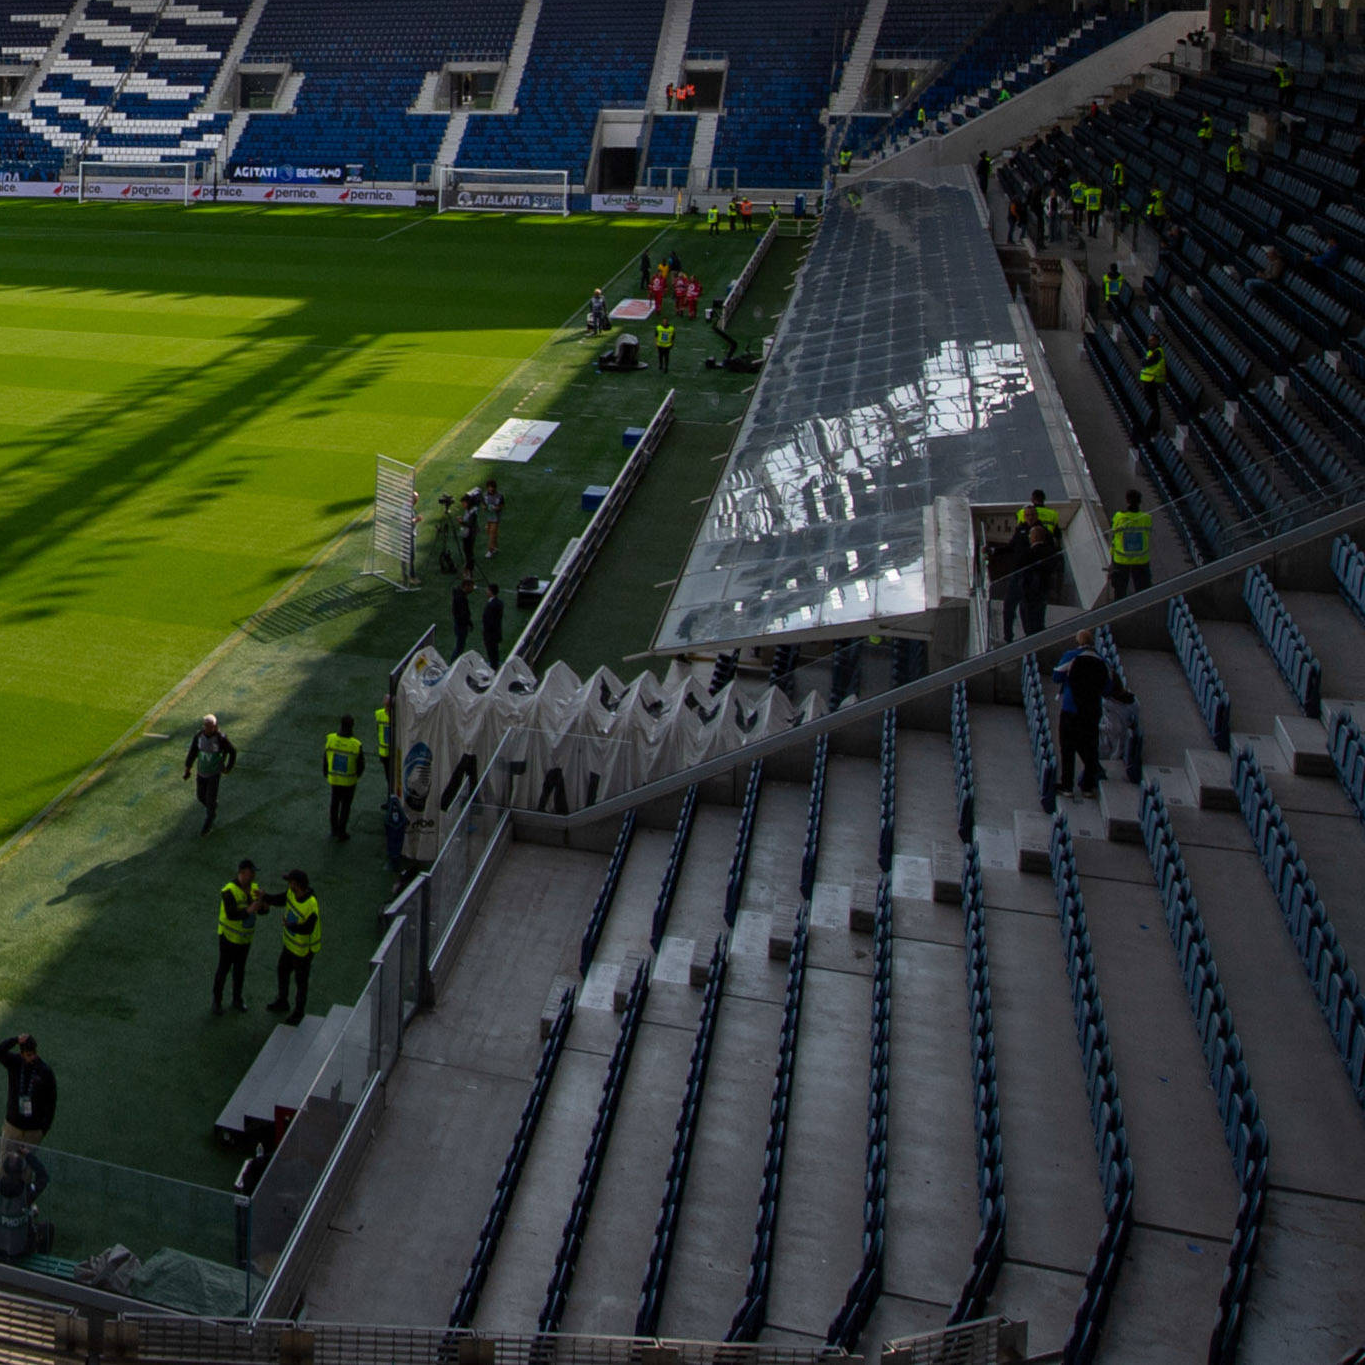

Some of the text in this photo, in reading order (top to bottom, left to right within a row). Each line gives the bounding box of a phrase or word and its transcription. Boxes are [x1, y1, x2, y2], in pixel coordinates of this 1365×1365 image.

[233, 166, 277, 178] AGITATI
[296, 166, 342, 179] BERGAMO
[473, 195, 530, 207] ATALANTA
